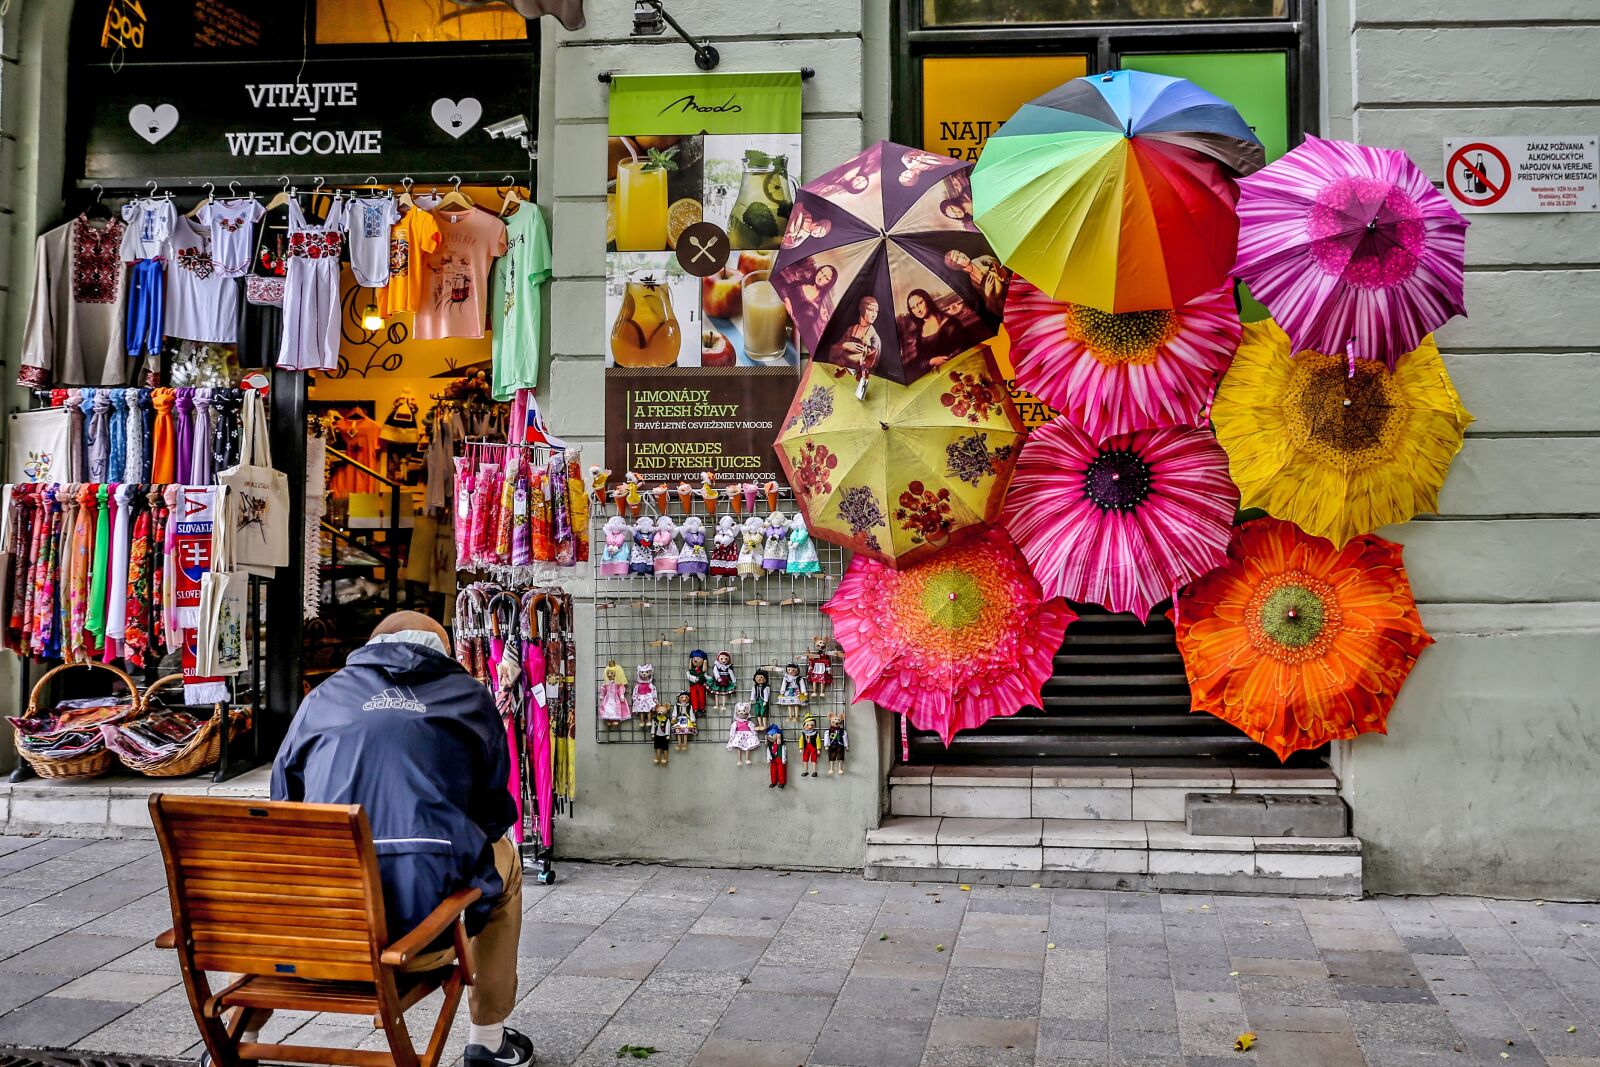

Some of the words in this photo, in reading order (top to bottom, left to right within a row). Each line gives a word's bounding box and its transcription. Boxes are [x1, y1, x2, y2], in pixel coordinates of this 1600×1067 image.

[245, 82, 358, 113] VITAJTE
[657, 93, 742, 118] Moods
[940, 121, 1008, 145] NAJL
[225, 130, 382, 156] WELCOME
[1527, 142, 1549, 151] ZÁKAZ
[1550, 142, 1584, 151] POŽÍVANIA
[1528, 152, 1584, 161] ALKOHOLICKÝCH
[1520, 162, 1551, 171] NÁPOJOV
[1563, 162, 1593, 170] VEREJNE
[1518, 172, 1563, 181] PRÍSTUPNÝCH
[1564, 172, 1597, 180] MIESTACH
[634, 388, 710, 402] LIMONÁDY
[634, 406, 646, 417] A
[648, 406, 692, 417] FRESH
[634, 421, 660, 429] PRAVÉ
[661, 421, 687, 429] LETNÉ
[688, 420, 734, 429] OSVIEŽENIE
[634, 443, 722, 455] LEMONADES
[634, 457, 666, 469] AND
[669, 457, 713, 468] FRESH
[713, 456, 761, 471] JUICES
[640, 472, 670, 480] RESHEN
[746, 472, 775, 480] MOODS
[363, 698, 427, 713] adidas
